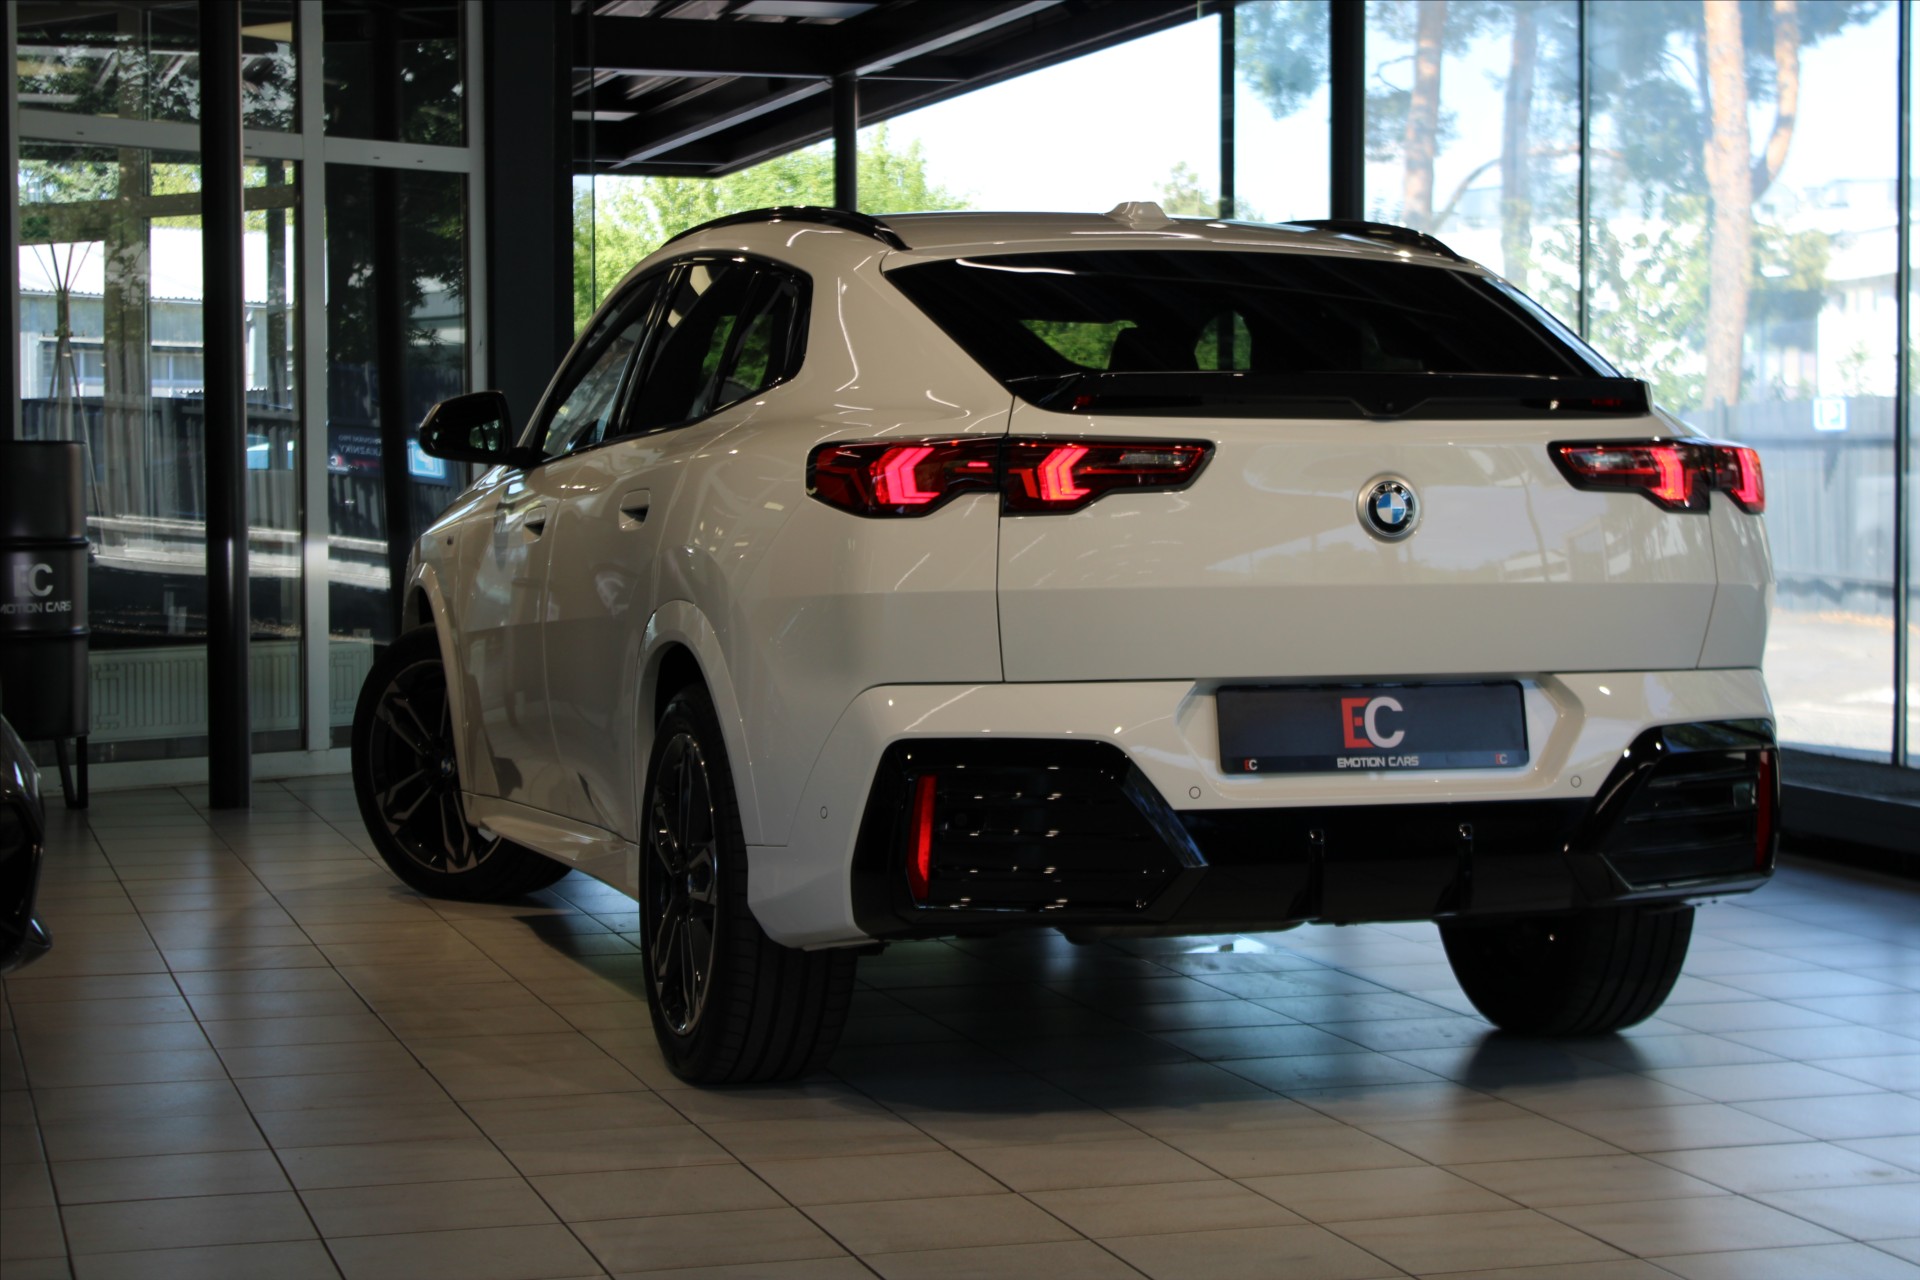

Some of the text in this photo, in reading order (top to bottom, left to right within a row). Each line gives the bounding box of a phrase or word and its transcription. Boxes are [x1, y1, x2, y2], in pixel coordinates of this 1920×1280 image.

[13, 563, 54, 597] EC
[45, 600, 72, 613] CARS
[1341, 696, 1406, 749] EC
[1244, 758, 1258, 772] EC
[1336, 755, 1420, 769] EMOTION CARS
[1495, 753, 1508, 765] EC
